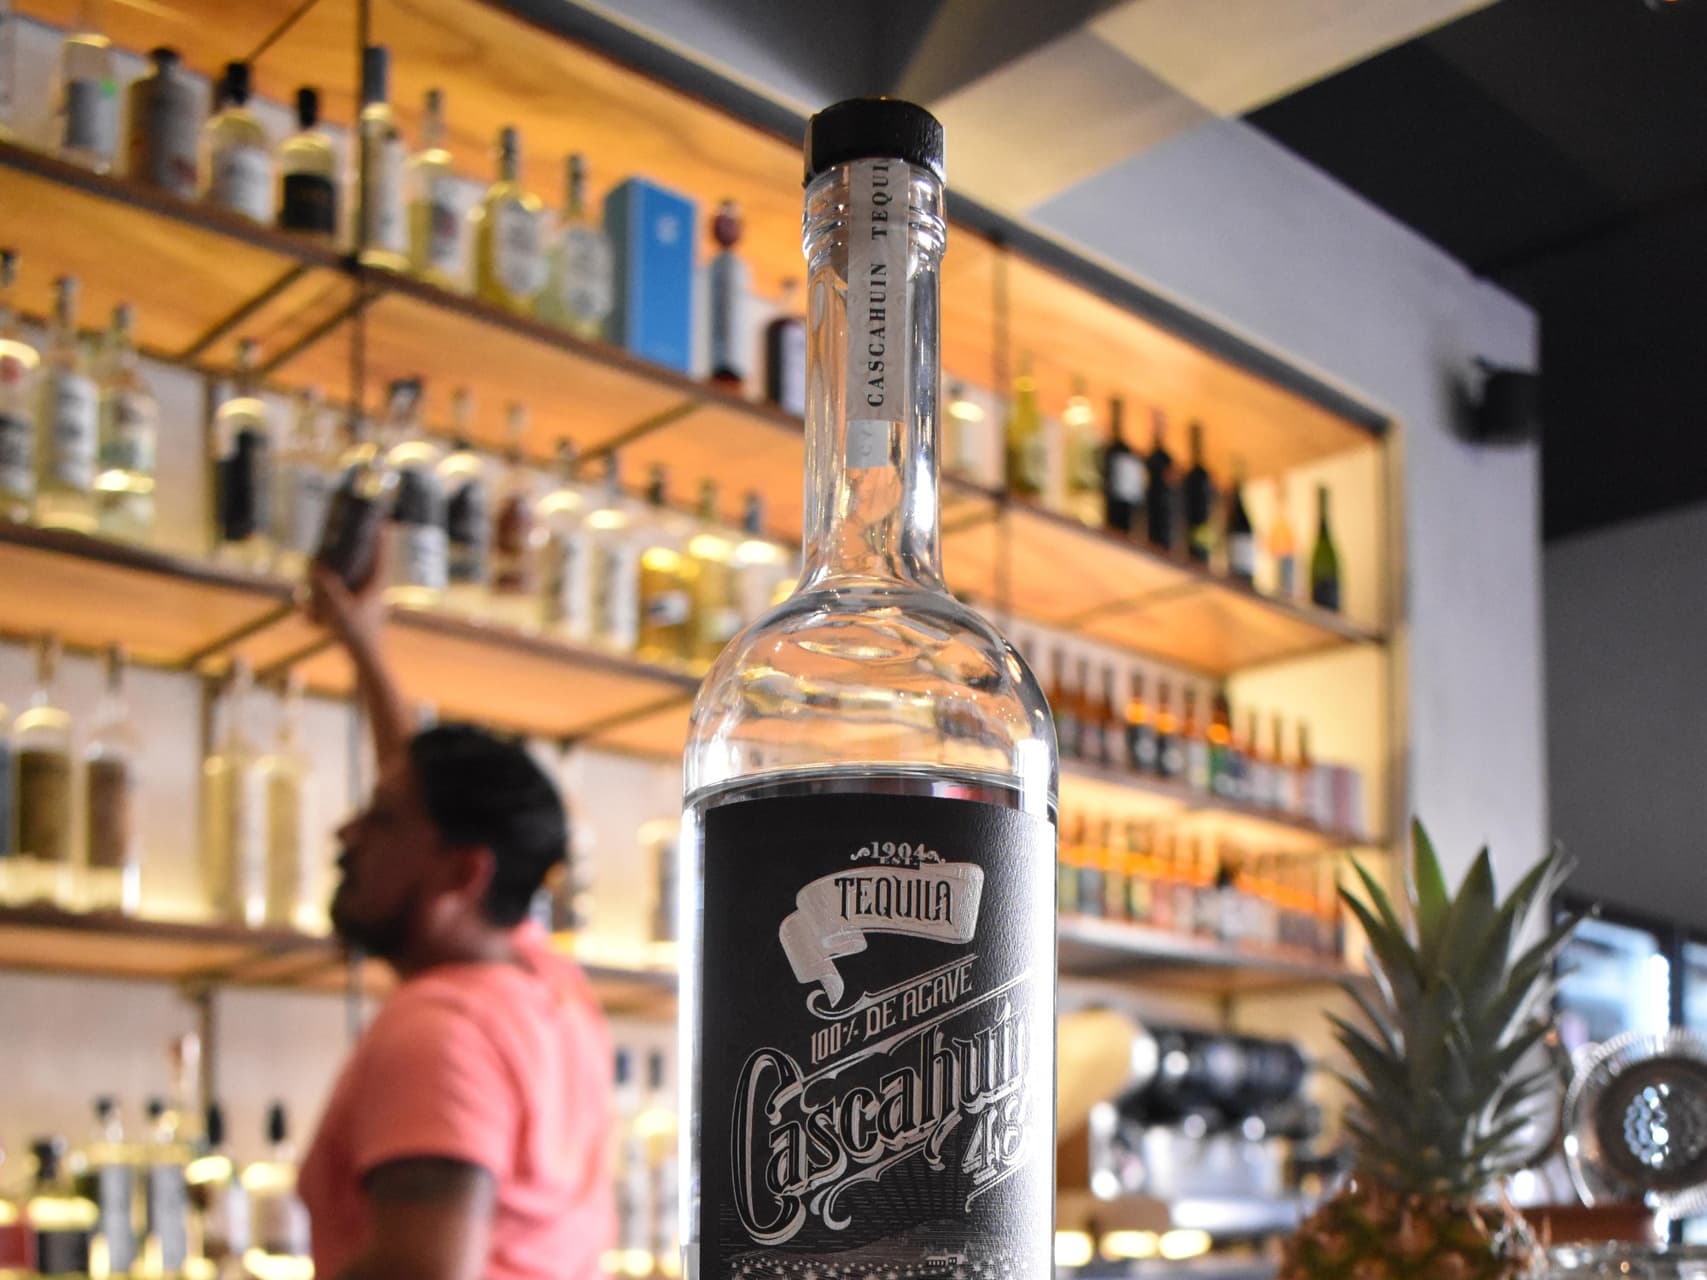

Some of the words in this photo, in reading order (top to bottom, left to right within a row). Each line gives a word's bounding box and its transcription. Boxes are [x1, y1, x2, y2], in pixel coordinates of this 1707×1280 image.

[871, 158, 893, 240] TEQUI
[867, 263, 887, 407] CASCAHUIN
[869, 840, 926, 860] 1904
[834, 875, 953, 925] TEQUILA
[811, 1017, 859, 1065] 100%
[863, 997, 897, 1041] DE
[902, 963, 974, 1021] AGAVE
[961, 1093, 1027, 1185] 48
